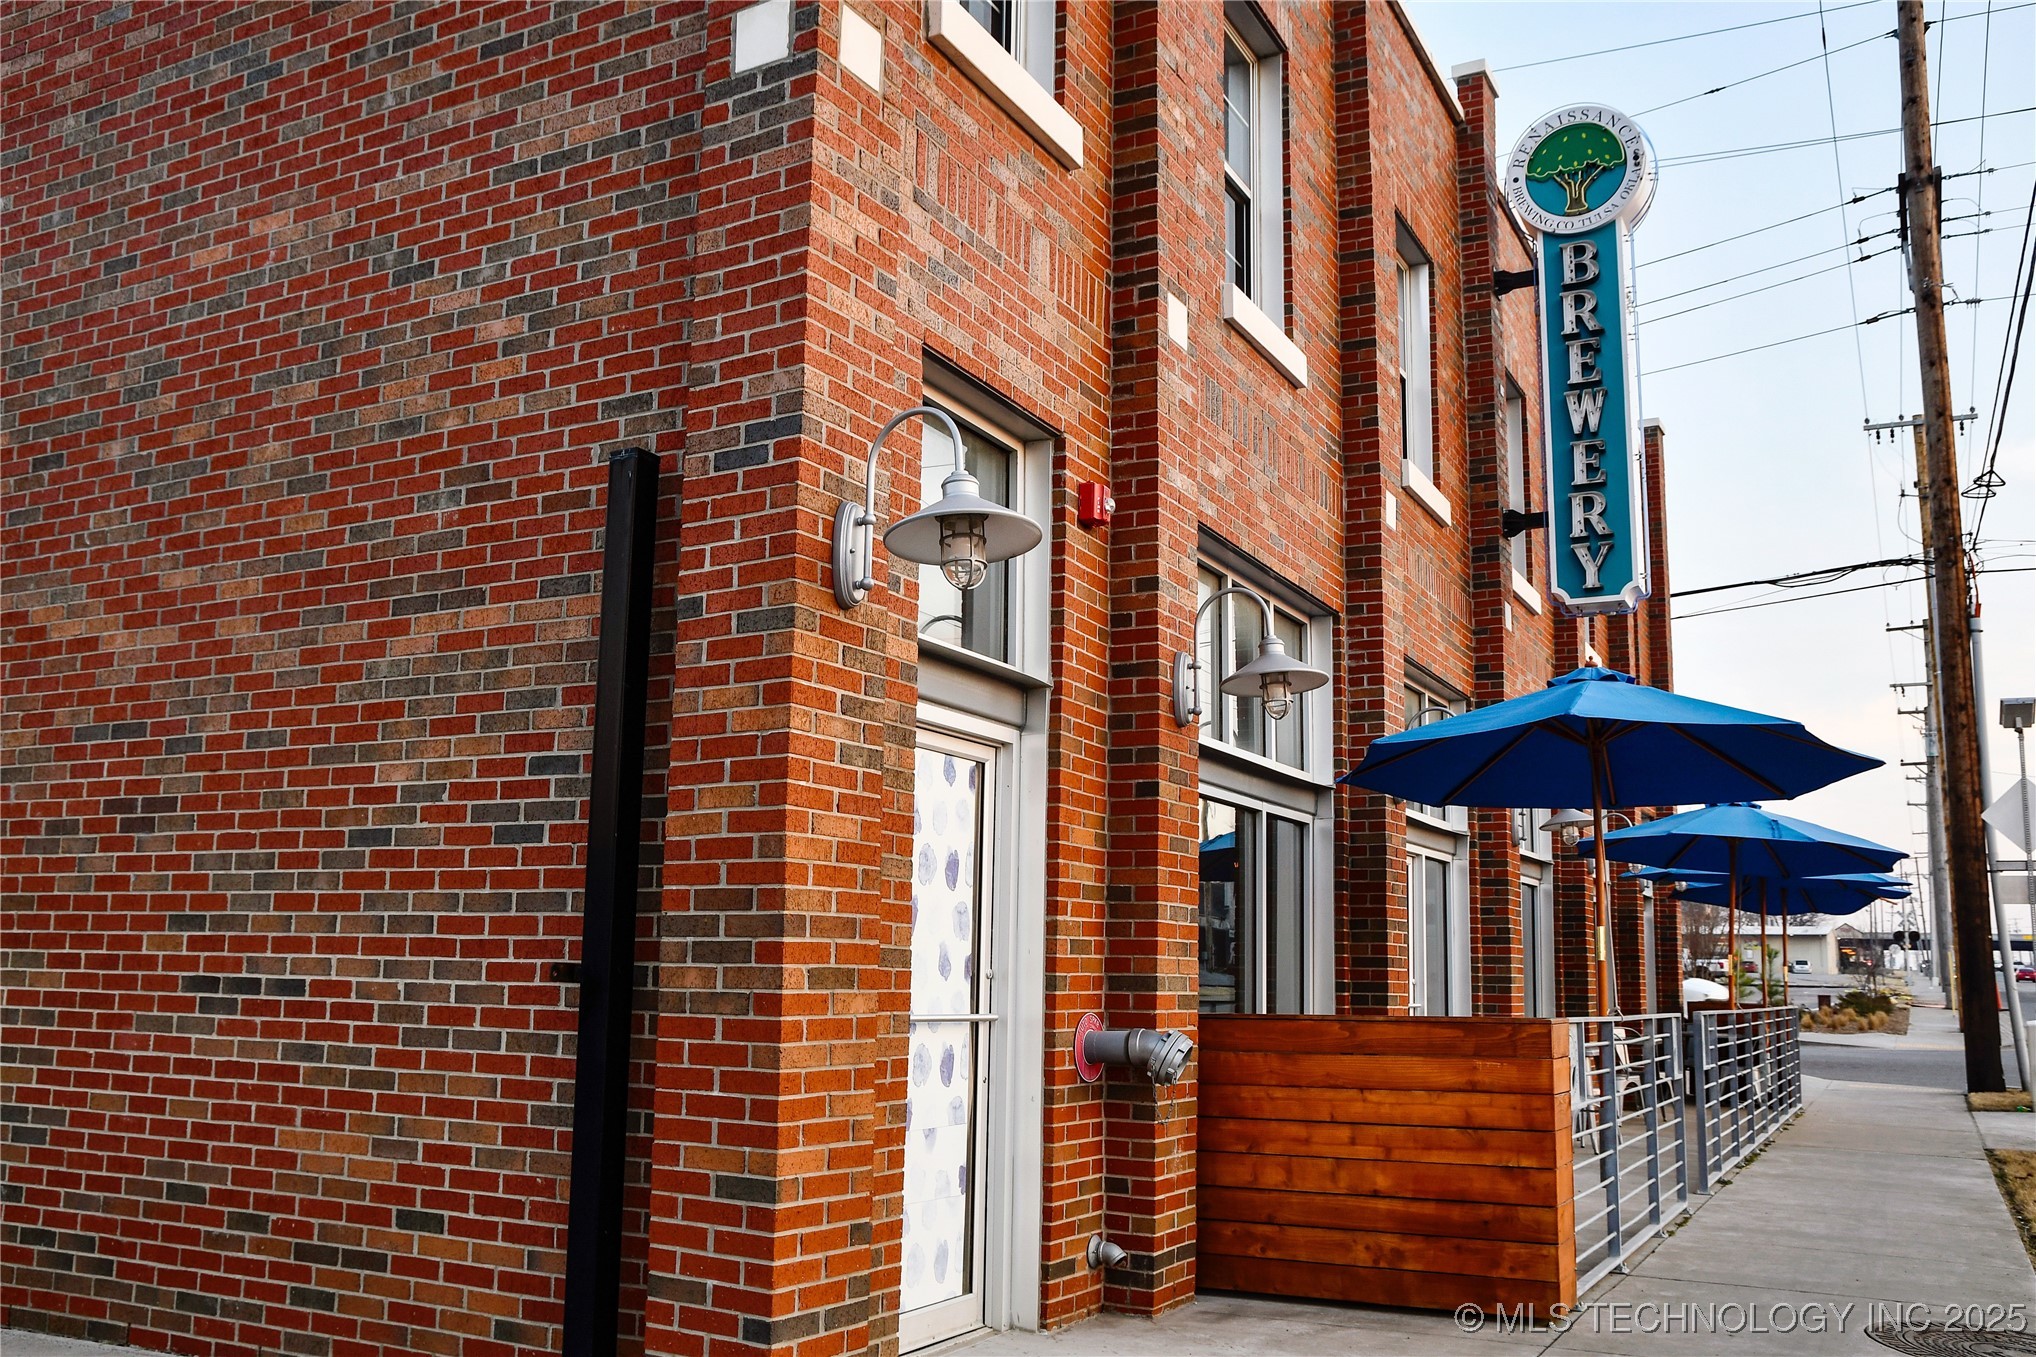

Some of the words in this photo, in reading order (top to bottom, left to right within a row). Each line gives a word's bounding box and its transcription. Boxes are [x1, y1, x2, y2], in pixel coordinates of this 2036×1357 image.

[1512, 109, 1640, 169] RENAISSANCE
[1512, 186, 1555, 229] BREWING
[1559, 239, 1615, 590] BREWERY
